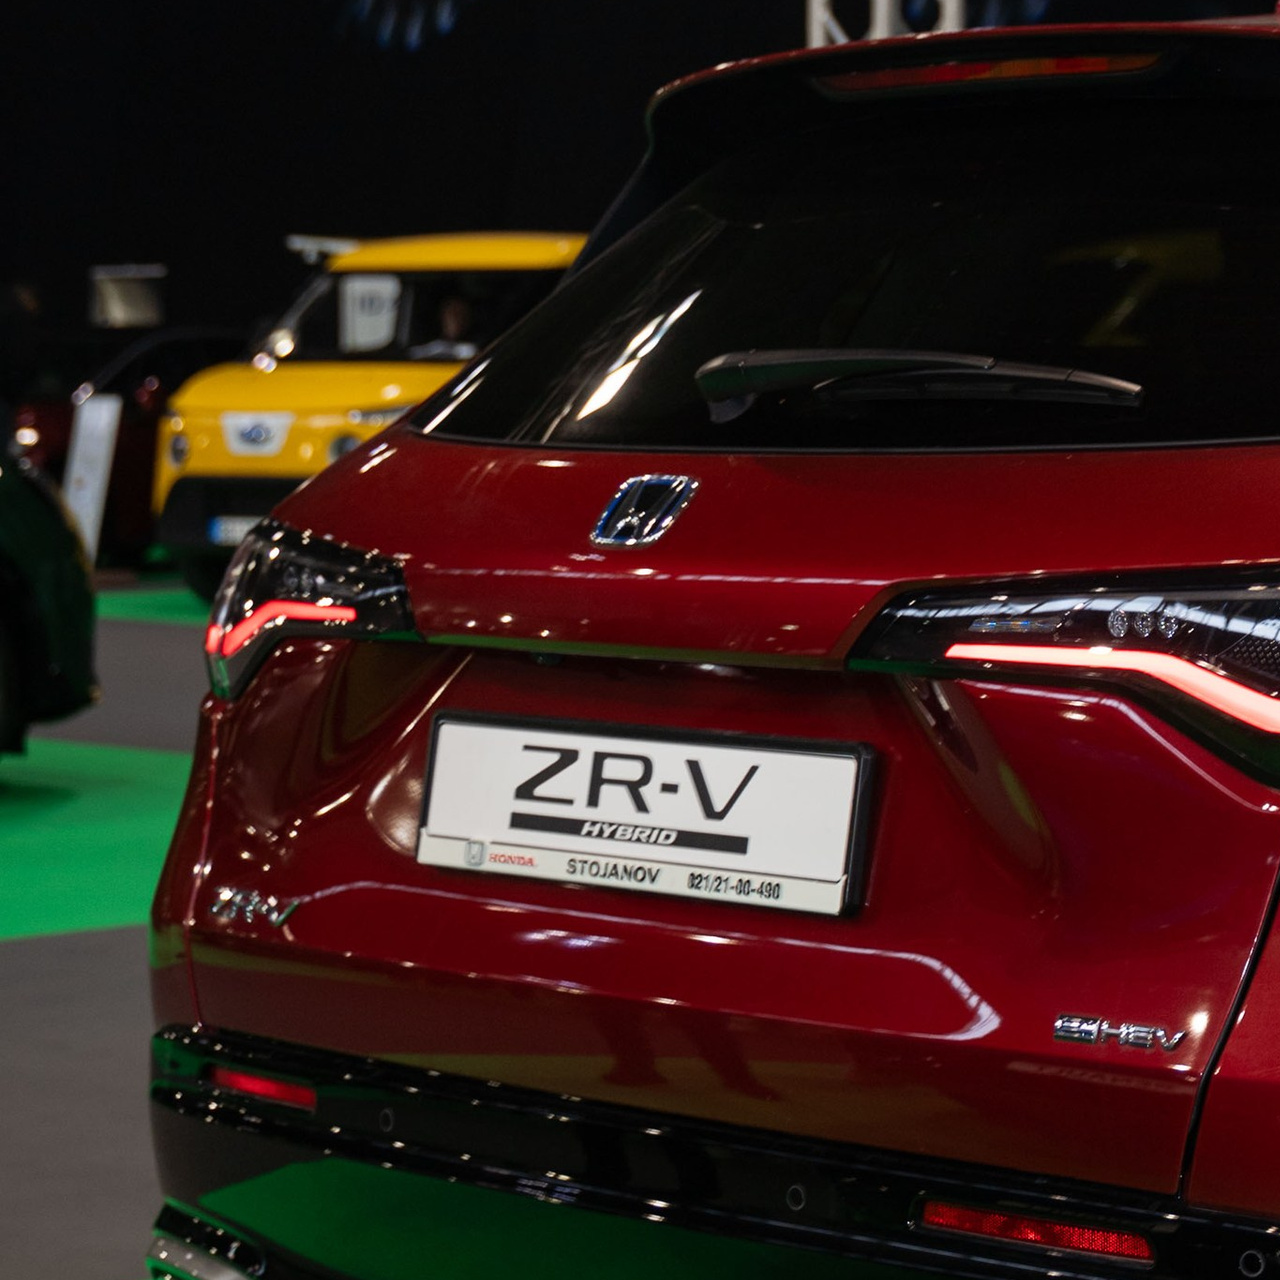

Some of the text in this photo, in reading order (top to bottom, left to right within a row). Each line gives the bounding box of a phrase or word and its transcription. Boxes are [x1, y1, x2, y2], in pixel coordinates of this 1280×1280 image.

[513, 744, 760, 821] ZR-V
[580, 821, 678, 847] HYBRID
[488, 852, 536, 868] HONDA
[566, 858, 661, 885] STOJANOV
